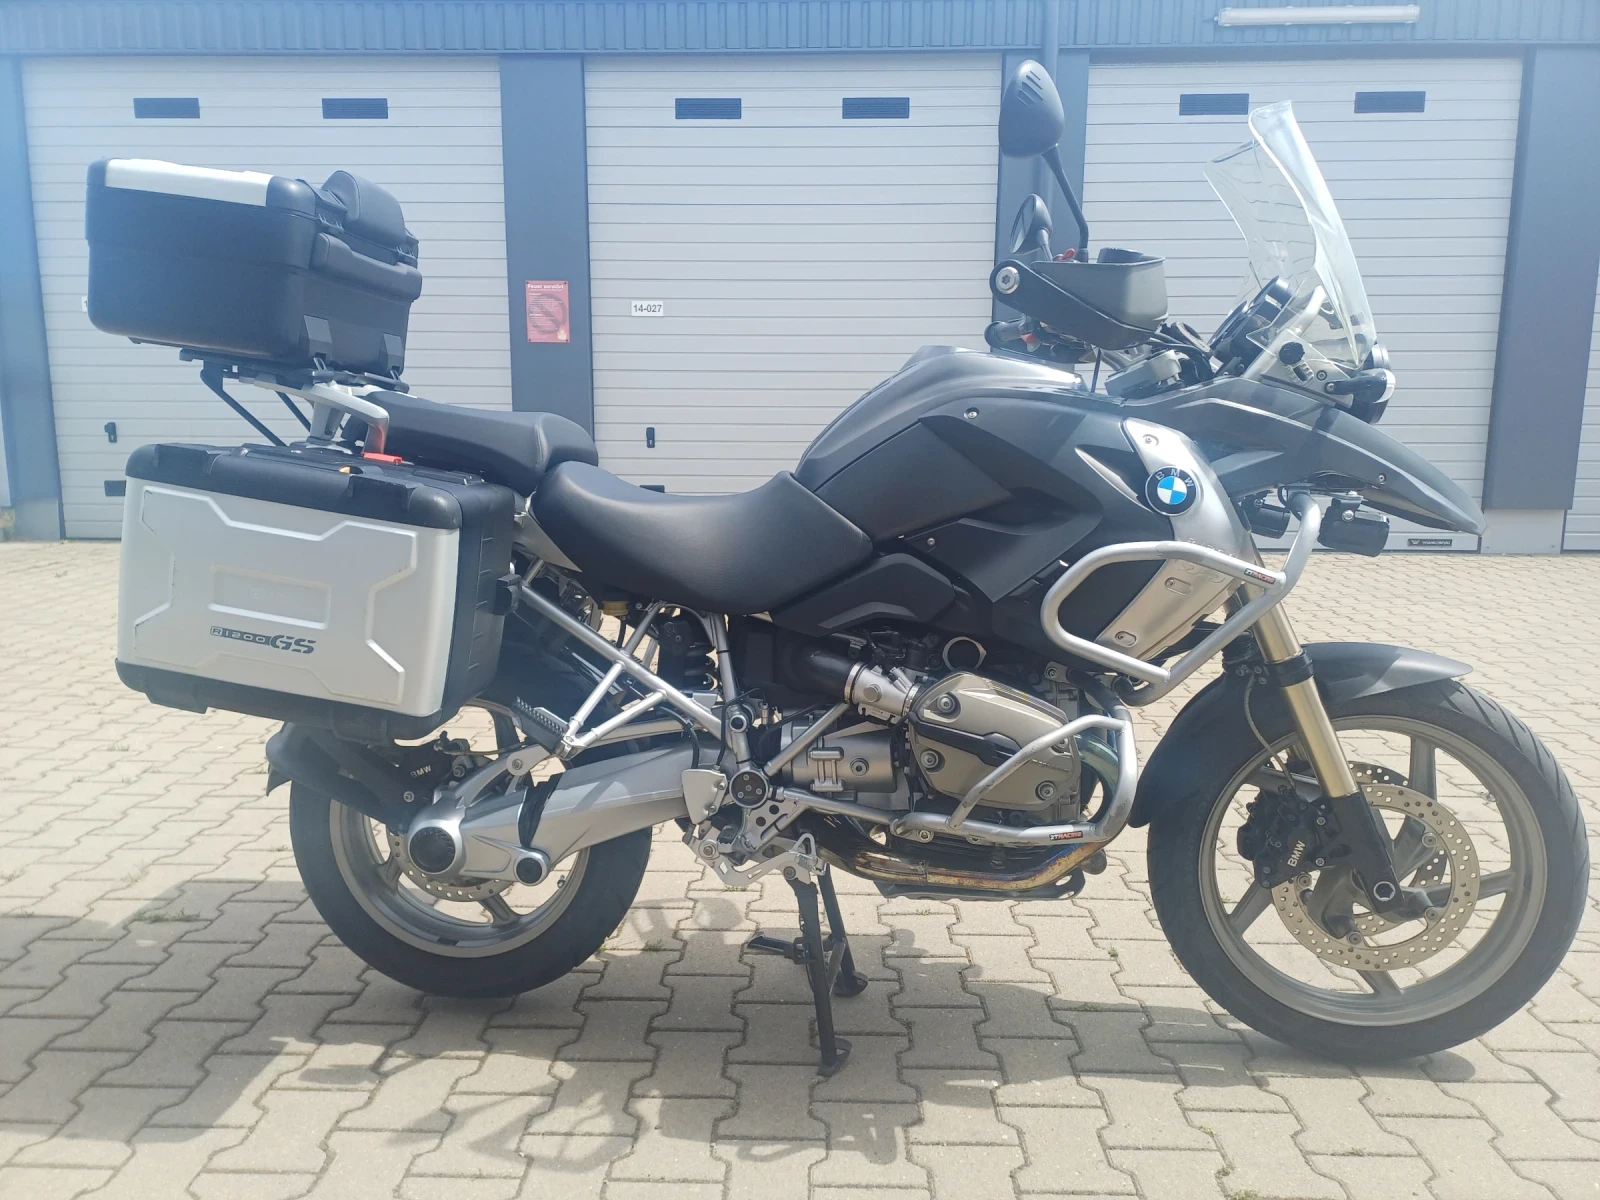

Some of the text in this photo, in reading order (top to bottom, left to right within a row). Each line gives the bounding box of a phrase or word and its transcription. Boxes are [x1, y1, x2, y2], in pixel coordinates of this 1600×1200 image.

[633, 304, 662, 313] 14-027
[1155, 468, 1194, 487] BMW
[410, 764, 432, 778] BMW
[1287, 840, 1306, 868] BMW
